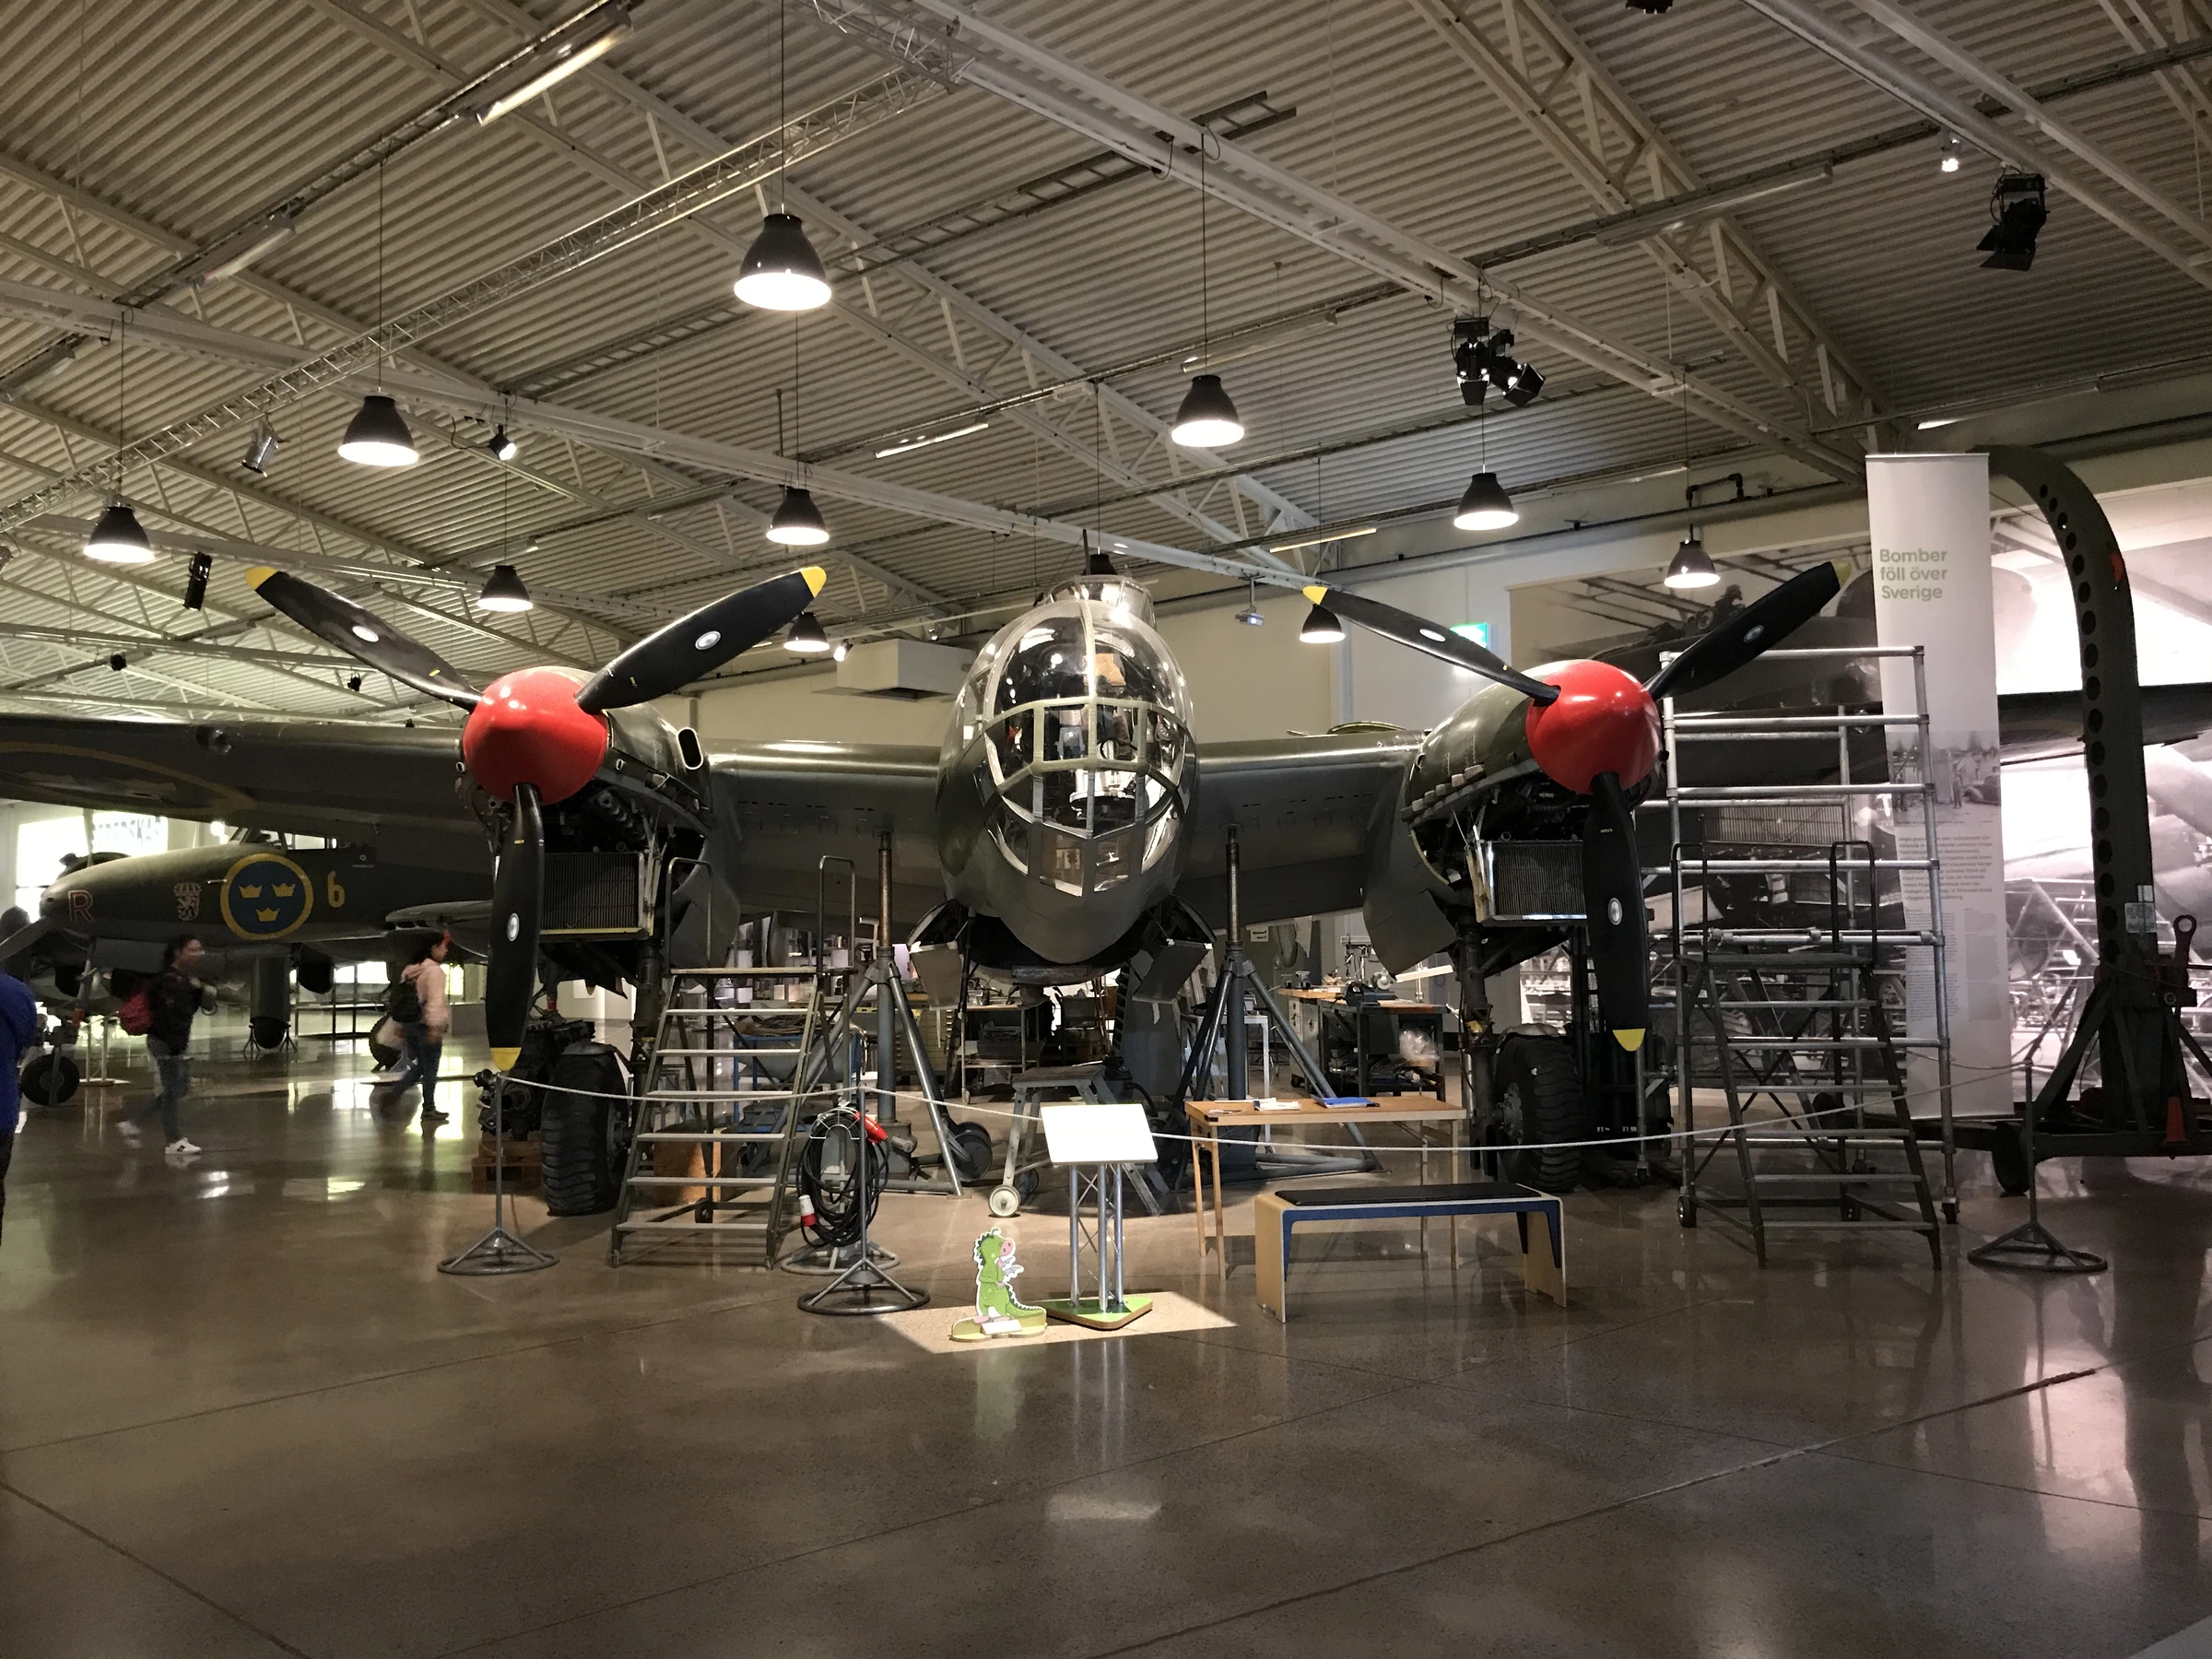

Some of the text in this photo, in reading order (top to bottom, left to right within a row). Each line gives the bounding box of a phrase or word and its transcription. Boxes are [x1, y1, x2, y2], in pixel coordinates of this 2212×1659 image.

[1879, 547, 1947, 563] Bomber
[1880, 566, 1948, 581] föll över
[1881, 584, 1943, 602] Sverige
[327, 870, 346, 908] 6
[68, 889, 95, 923] R
